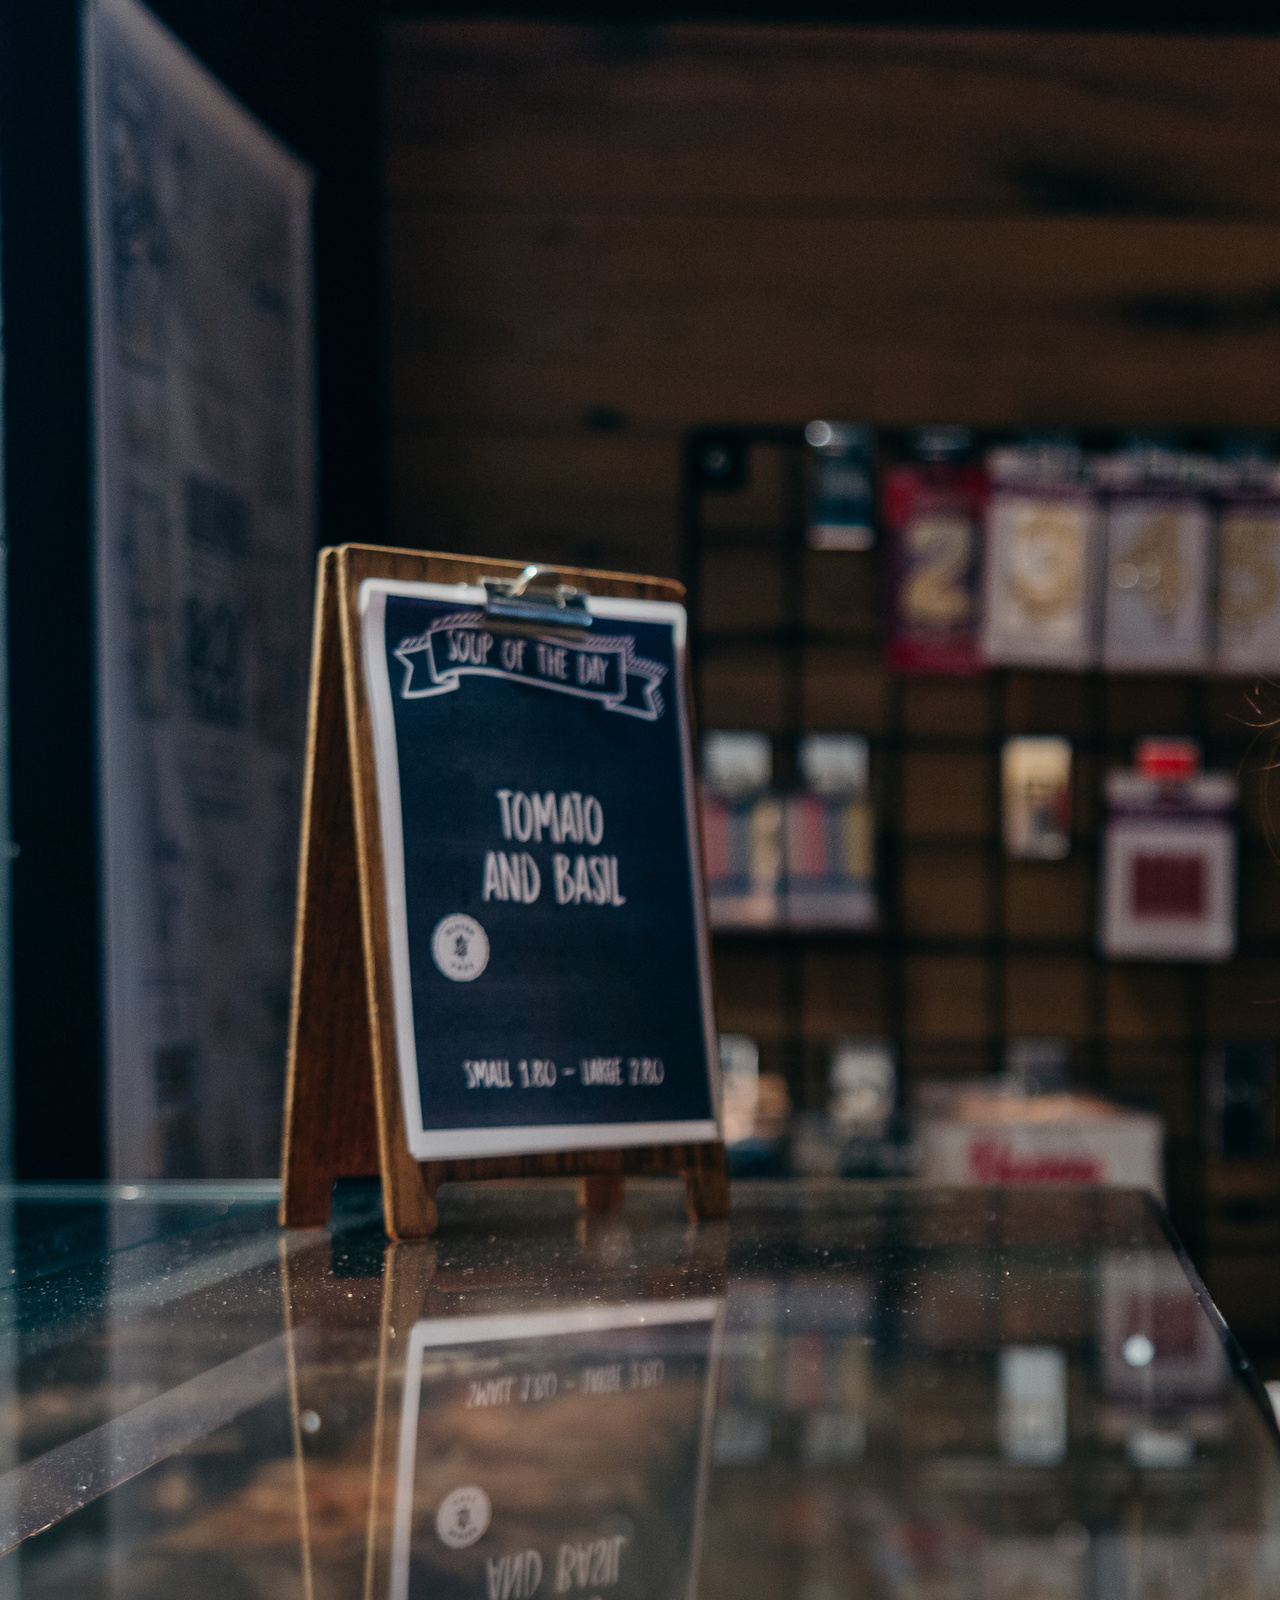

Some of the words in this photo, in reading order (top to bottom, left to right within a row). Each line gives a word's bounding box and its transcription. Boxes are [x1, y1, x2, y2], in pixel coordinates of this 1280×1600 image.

[447, 629, 494, 665] SOUP
[501, 639, 526, 672] OF
[536, 644, 568, 680] THE
[577, 653, 609, 685] DAY
[495, 789, 604, 847] TOMATO
[482, 850, 541, 905] AND
[553, 853, 627, 907] BASIL
[463, 1058, 514, 1089] SMALL
[580, 1056, 624, 1087] LARGE
